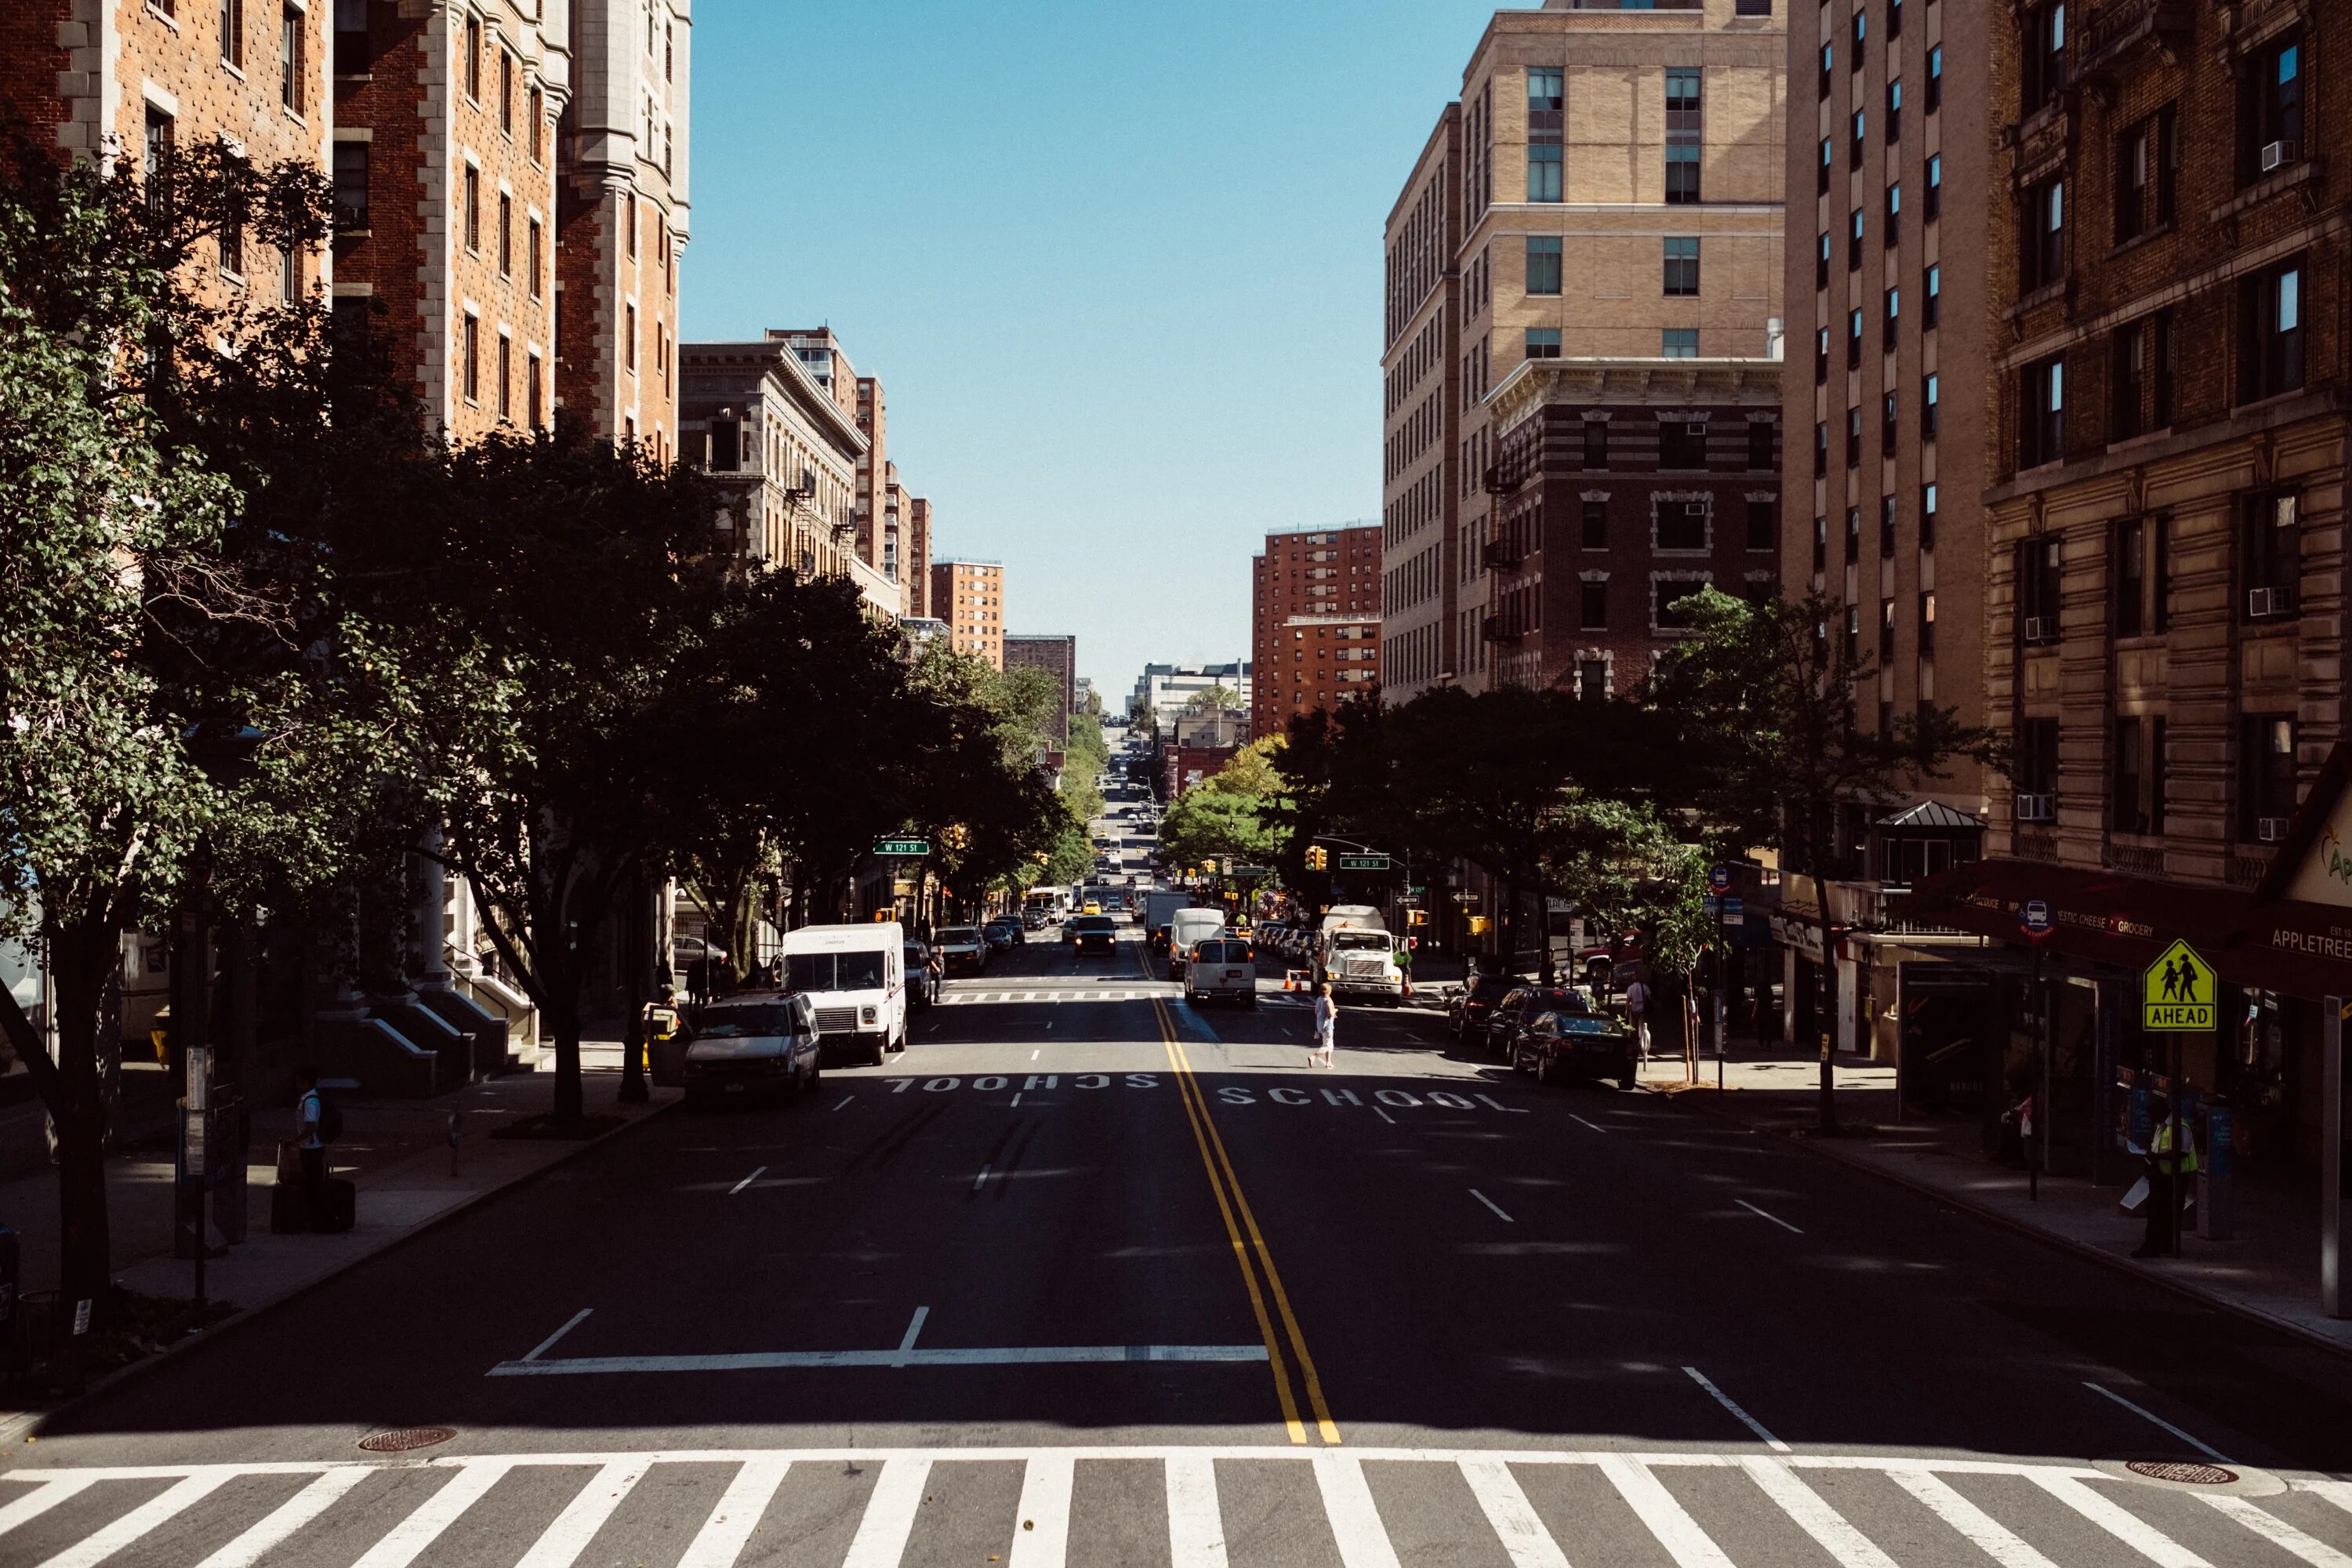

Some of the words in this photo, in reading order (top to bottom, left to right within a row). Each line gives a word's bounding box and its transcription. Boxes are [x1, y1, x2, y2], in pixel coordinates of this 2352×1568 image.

[885, 844, 893, 852] W
[895, 844, 906, 852] 121
[909, 844, 917, 852] St
[2057, 909, 2078, 923] ESTIC
[2079, 913, 2107, 928] CHEESE
[2118, 920, 2154, 938] GROCERY
[2272, 930, 2352, 960] APPLETREE
[2343, 930, 2352, 940] 19
[2152, 1008, 2209, 1023] AHEAD
[883, 1074, 1160, 1094] SCHOOL
[1217, 1087, 1530, 1113] SCHOOL
